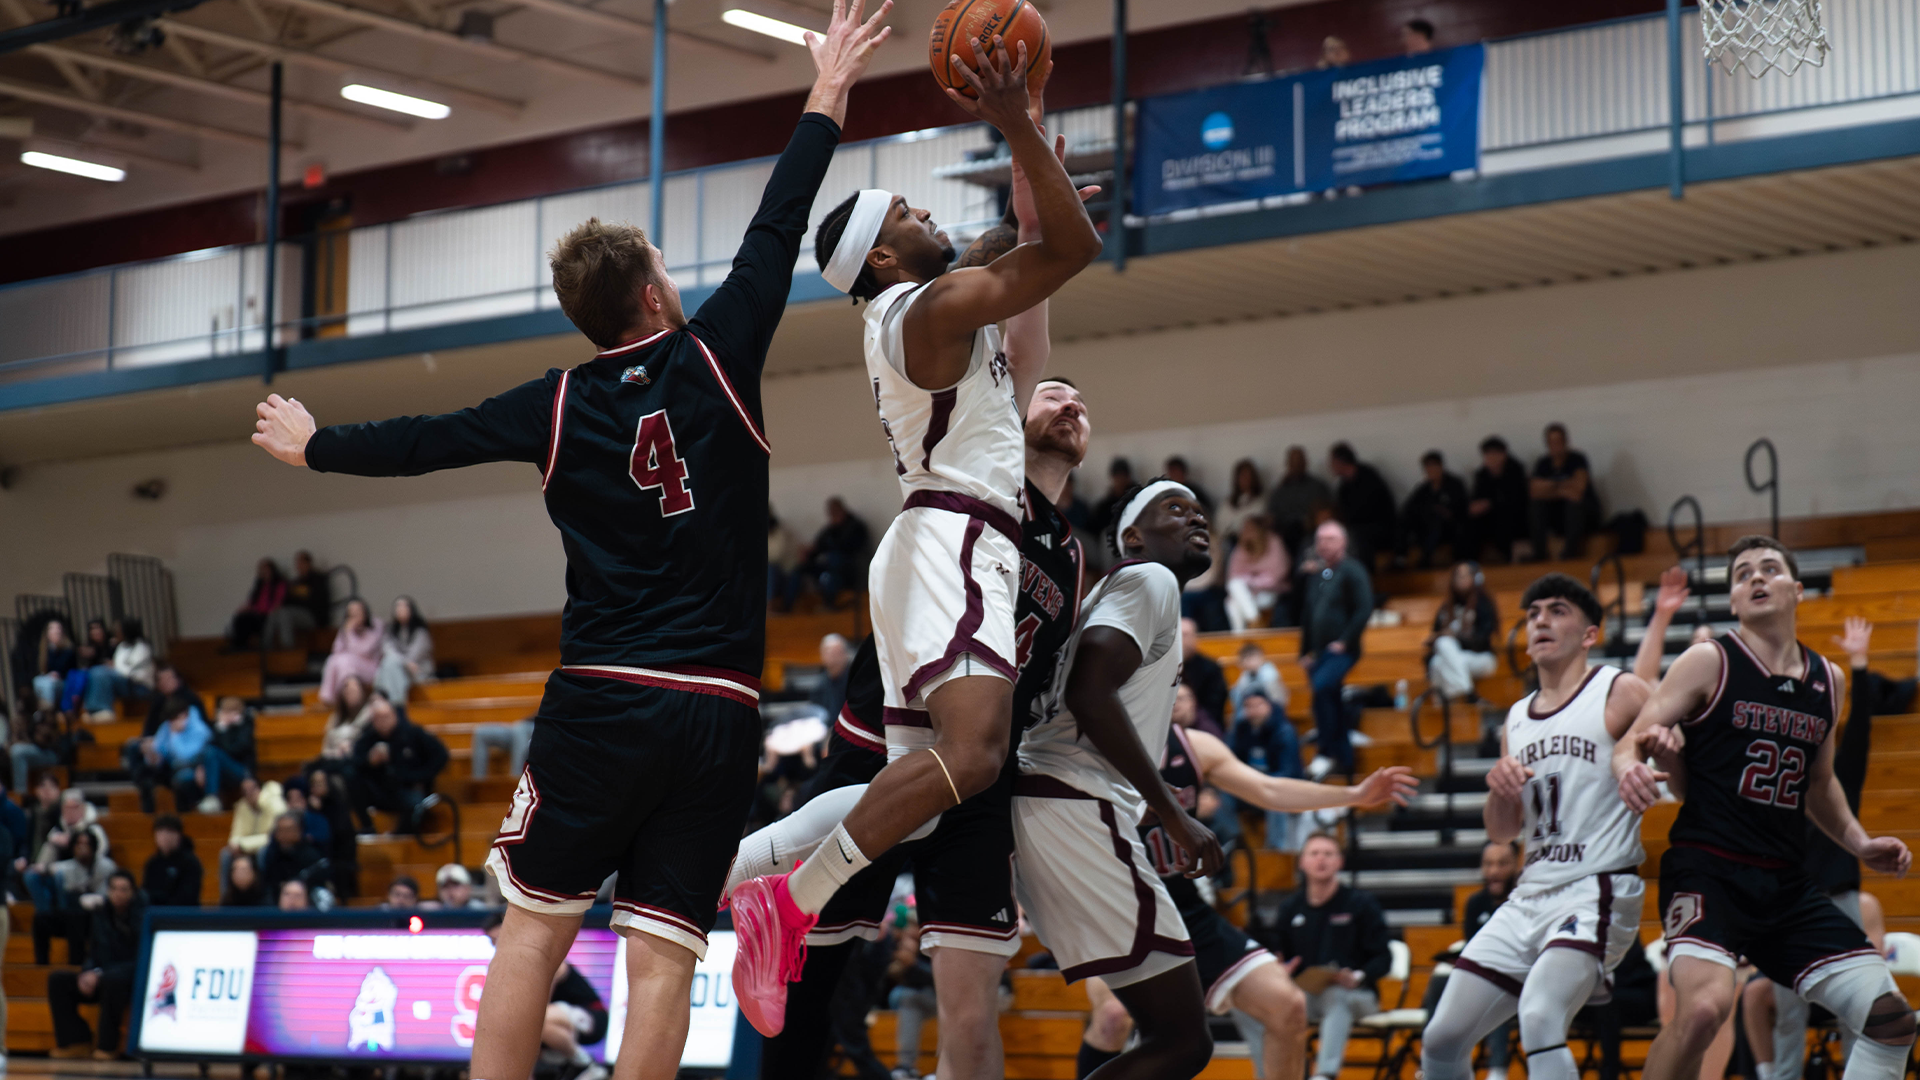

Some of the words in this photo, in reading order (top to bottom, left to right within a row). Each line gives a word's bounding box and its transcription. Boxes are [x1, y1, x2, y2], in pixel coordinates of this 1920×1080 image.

[978, 13, 1003, 44] ROCK
[1332, 65, 1443, 102] INCLUSIVE
[1340, 86, 1436, 119] LEADERS
[1335, 105, 1441, 141] PROGRAM
[1162, 148, 1252, 181] DIVISION
[629, 408, 696, 518] 4
[1732, 700, 1828, 744] STEVENS
[1738, 739, 1806, 810] 22
[1531, 770, 1562, 840] 11
[191, 968, 244, 1001] FDU
[689, 973, 733, 1008] DU
